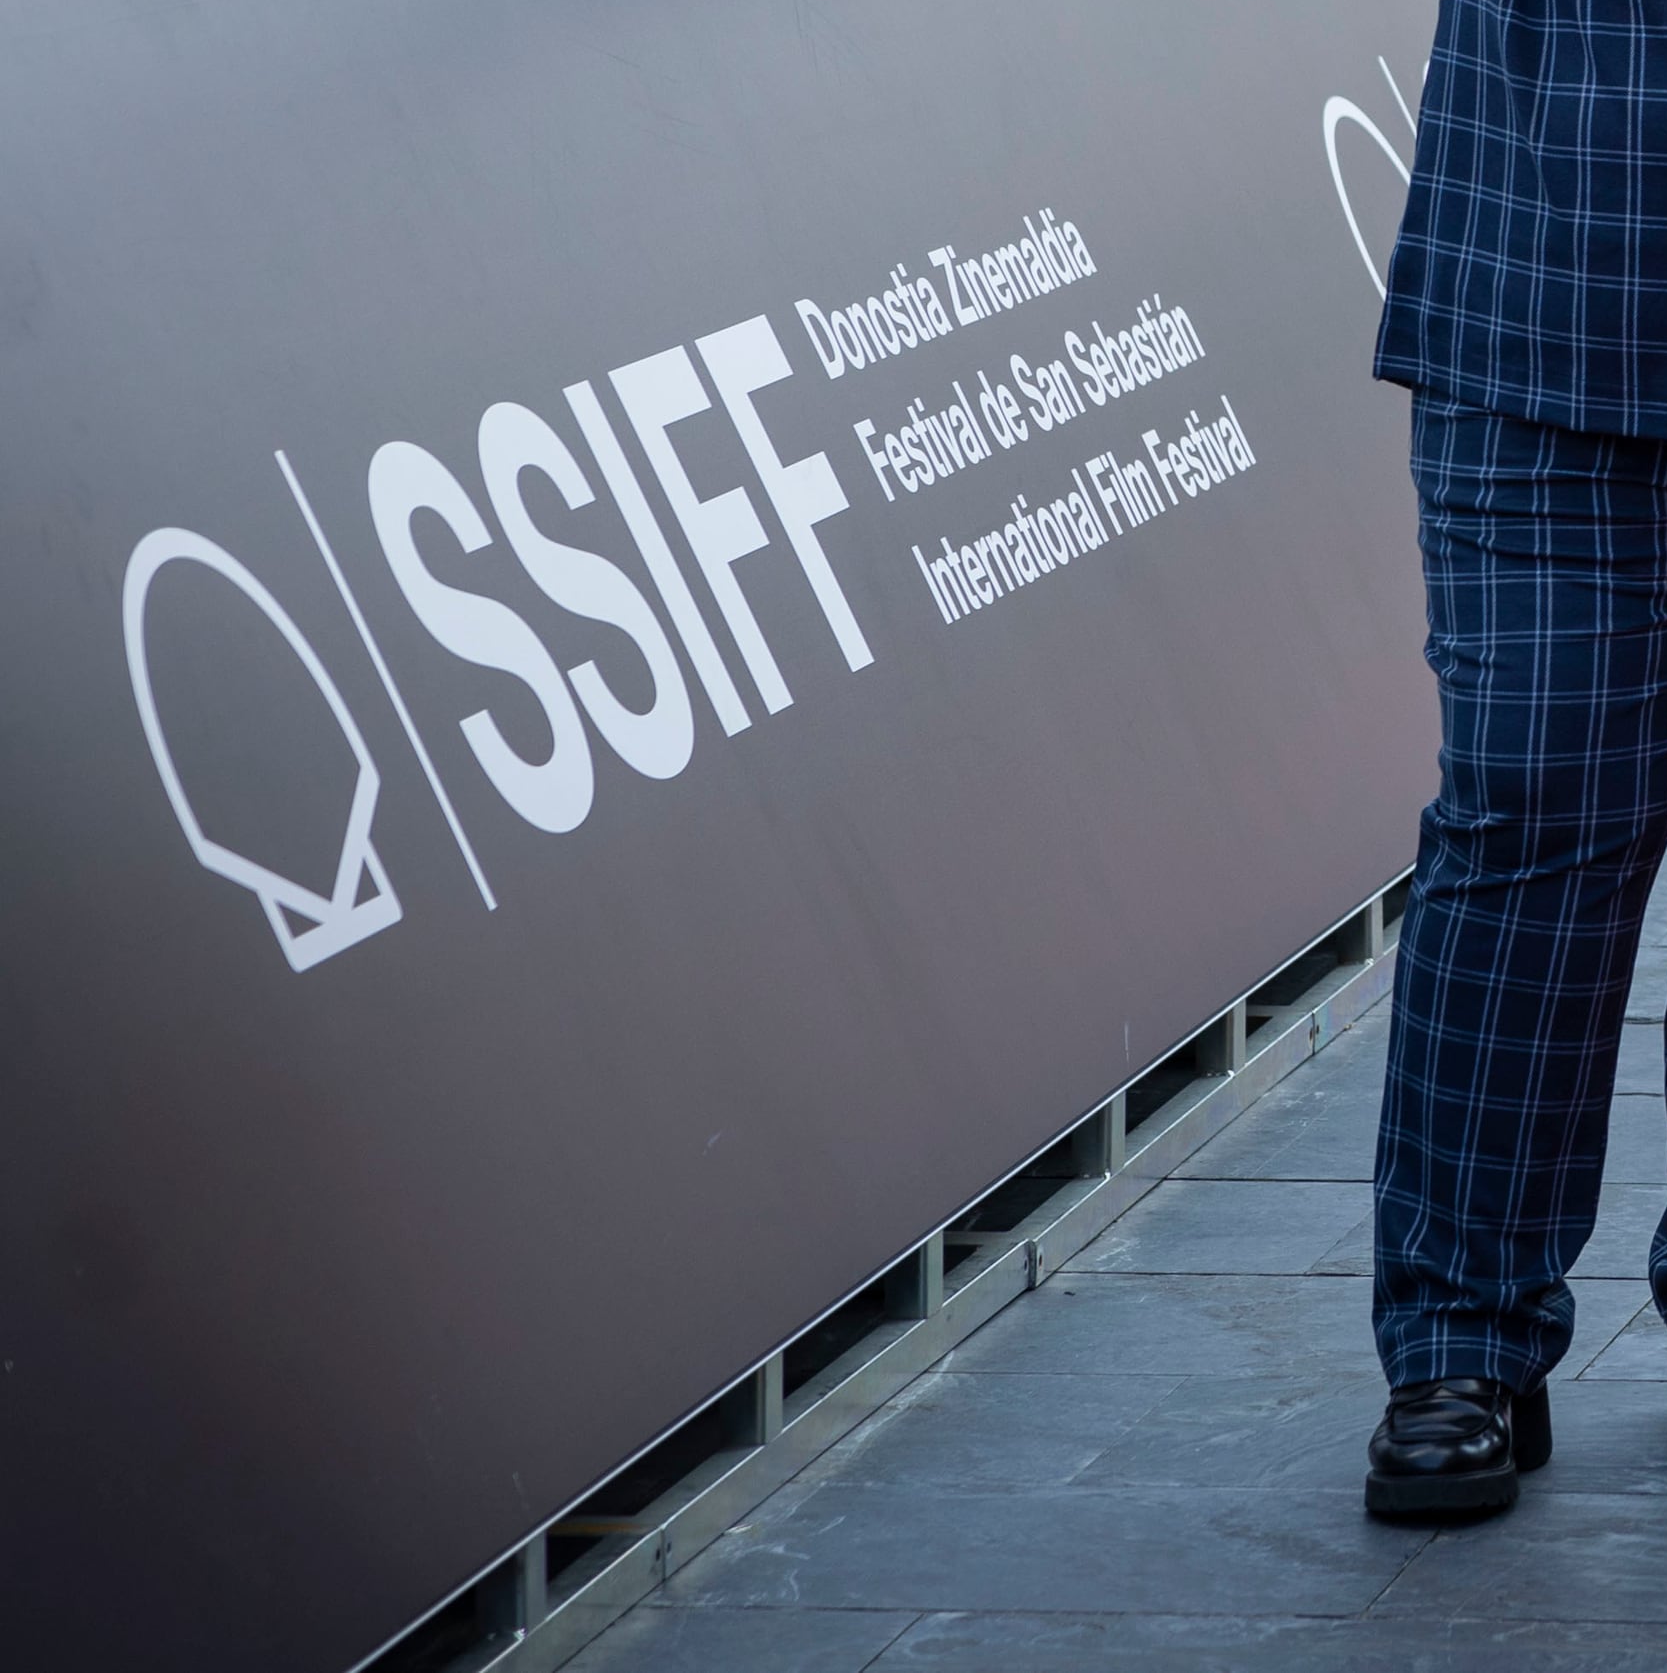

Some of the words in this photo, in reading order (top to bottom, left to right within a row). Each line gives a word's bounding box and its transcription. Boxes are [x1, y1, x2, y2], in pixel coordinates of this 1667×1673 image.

[794, 263, 954, 380] Donostia
[928, 207, 1097, 327] Zinemaldia
[853, 380, 992, 502] Festival
[976, 370, 1029, 450] de
[1010, 354, 1086, 431] San
[1064, 293, 1206, 406] Sebastián
[368, 314, 875, 834] SSIFF
[912, 468, 1109, 624] International
[1085, 451, 1166, 535] Film
[1142, 395, 1257, 505] Festival
